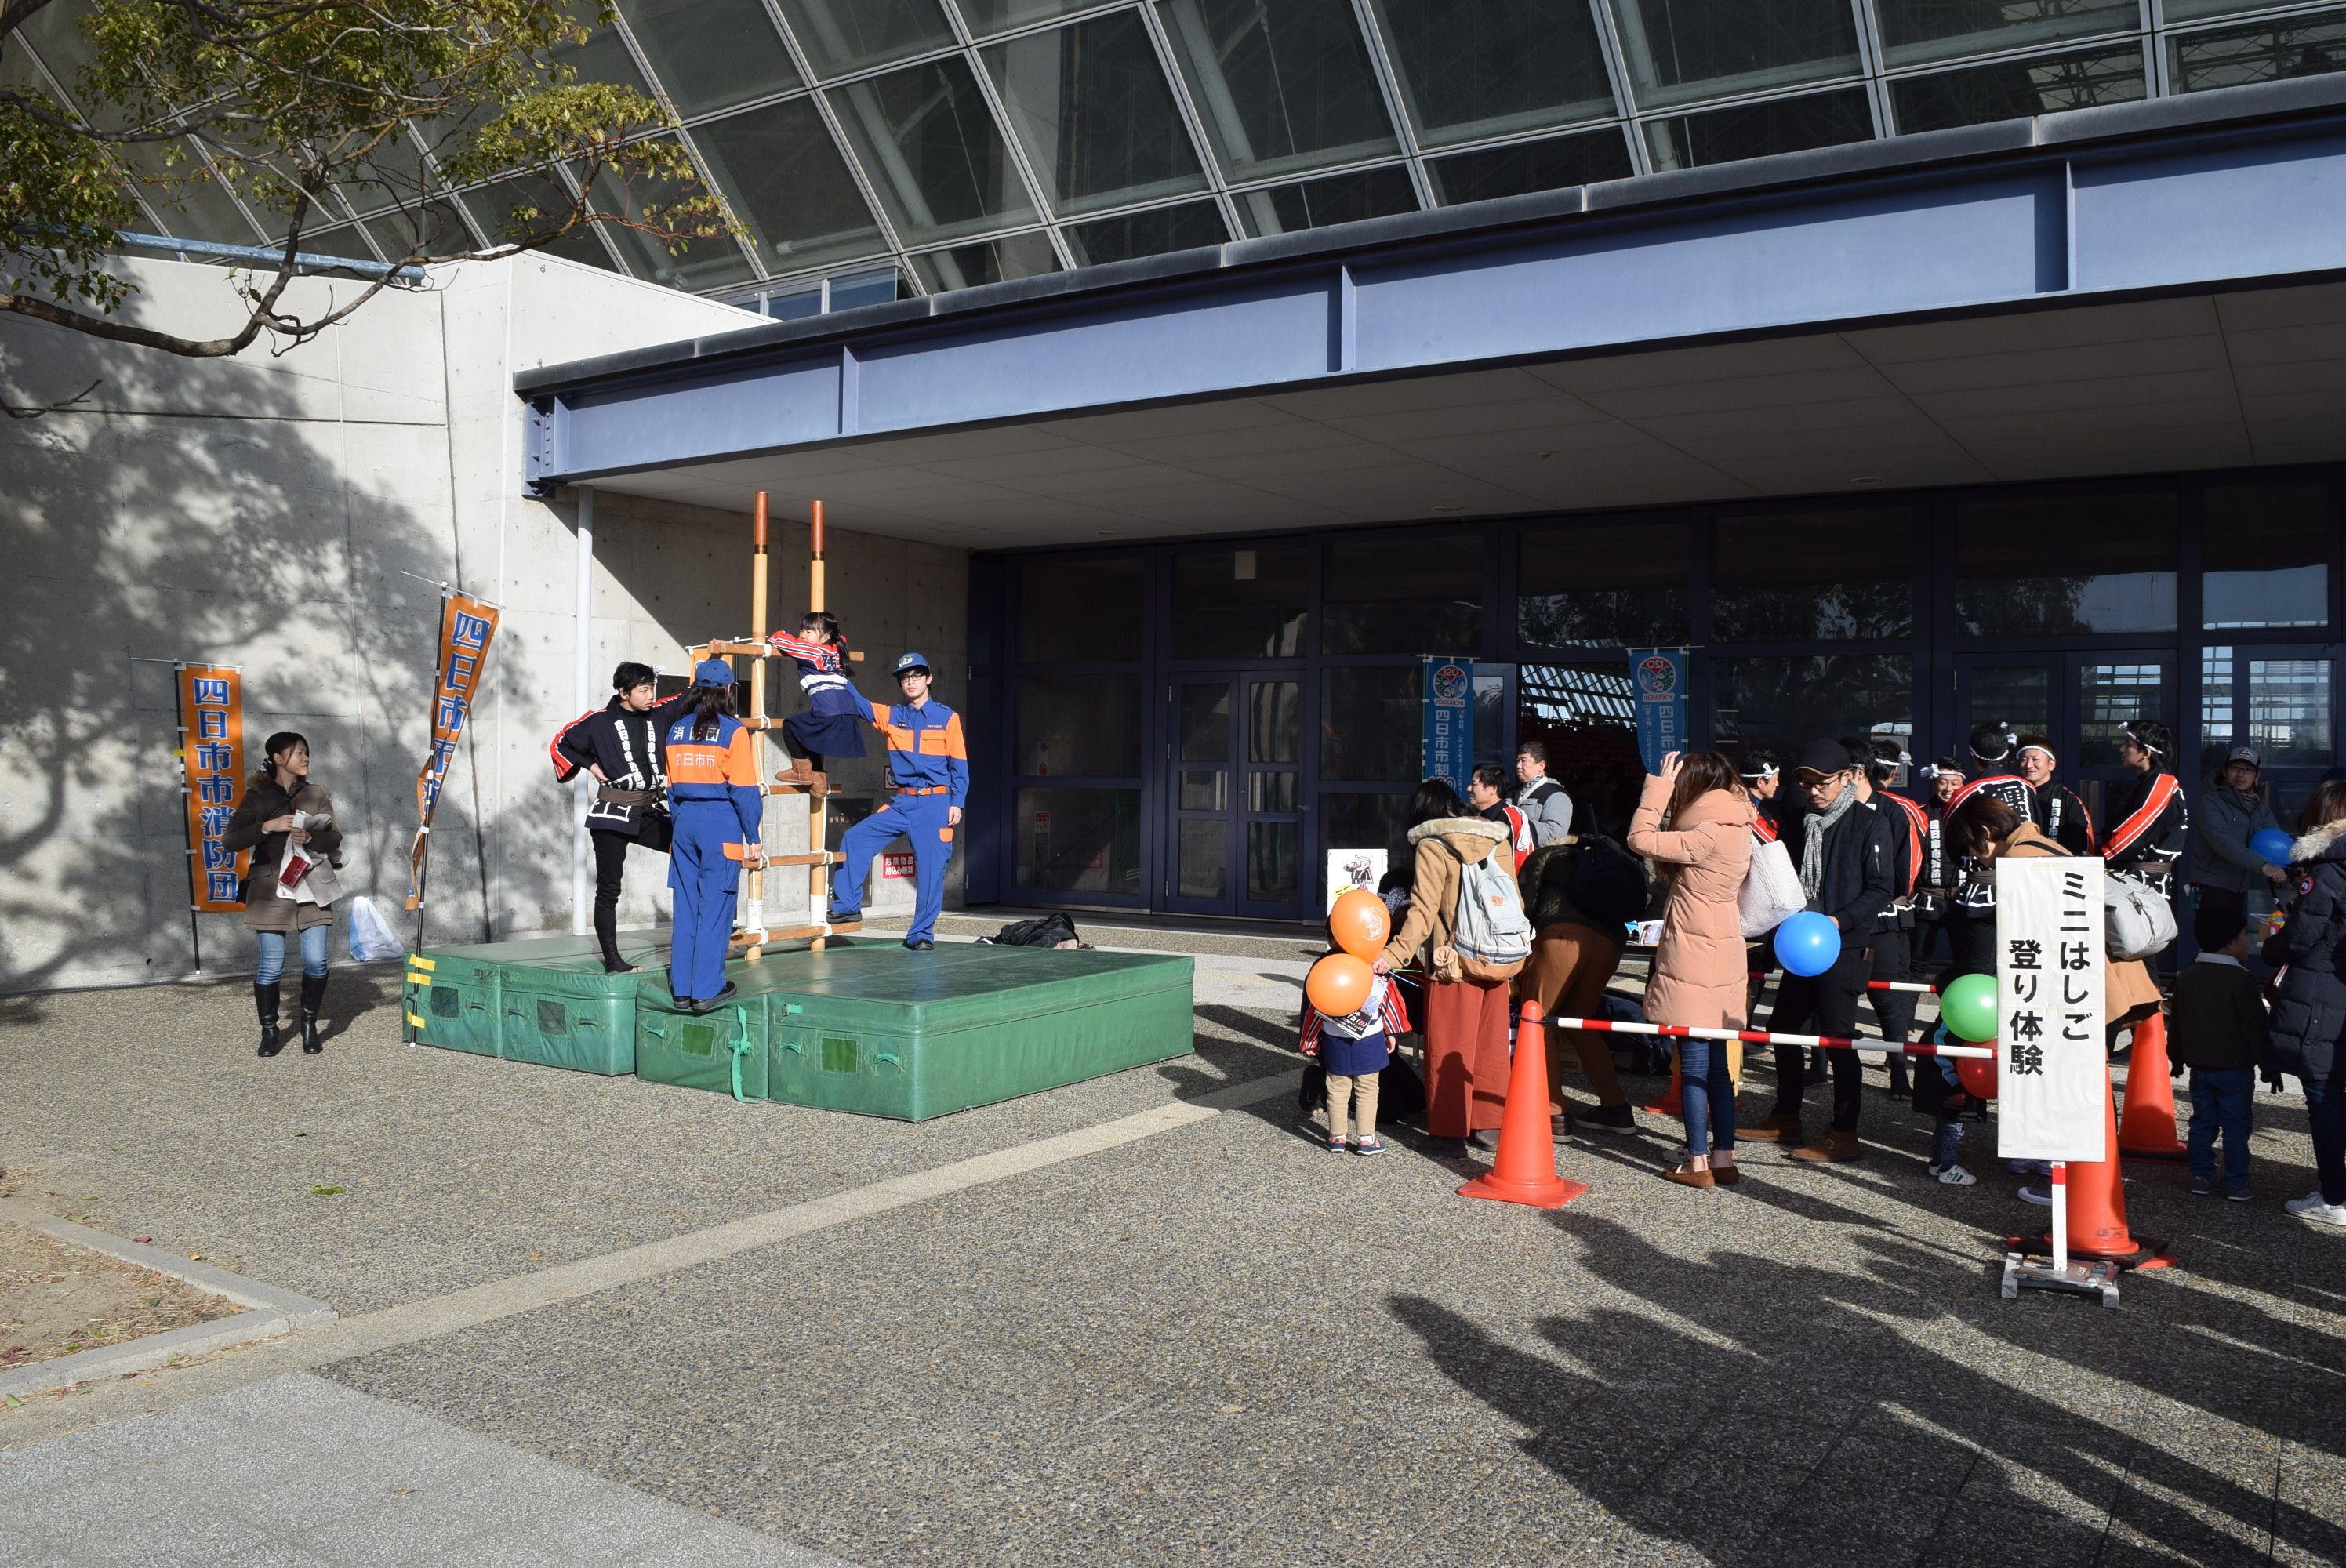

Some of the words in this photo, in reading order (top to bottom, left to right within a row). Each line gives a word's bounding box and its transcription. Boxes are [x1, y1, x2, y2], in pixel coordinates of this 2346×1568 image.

[1444, 667, 1458, 676] 120
[193, 677, 238, 902] 四日市市消防団
[2009, 939, 2043, 1076] 登り体験
[2060, 872, 2092, 1041] ミニはしご
